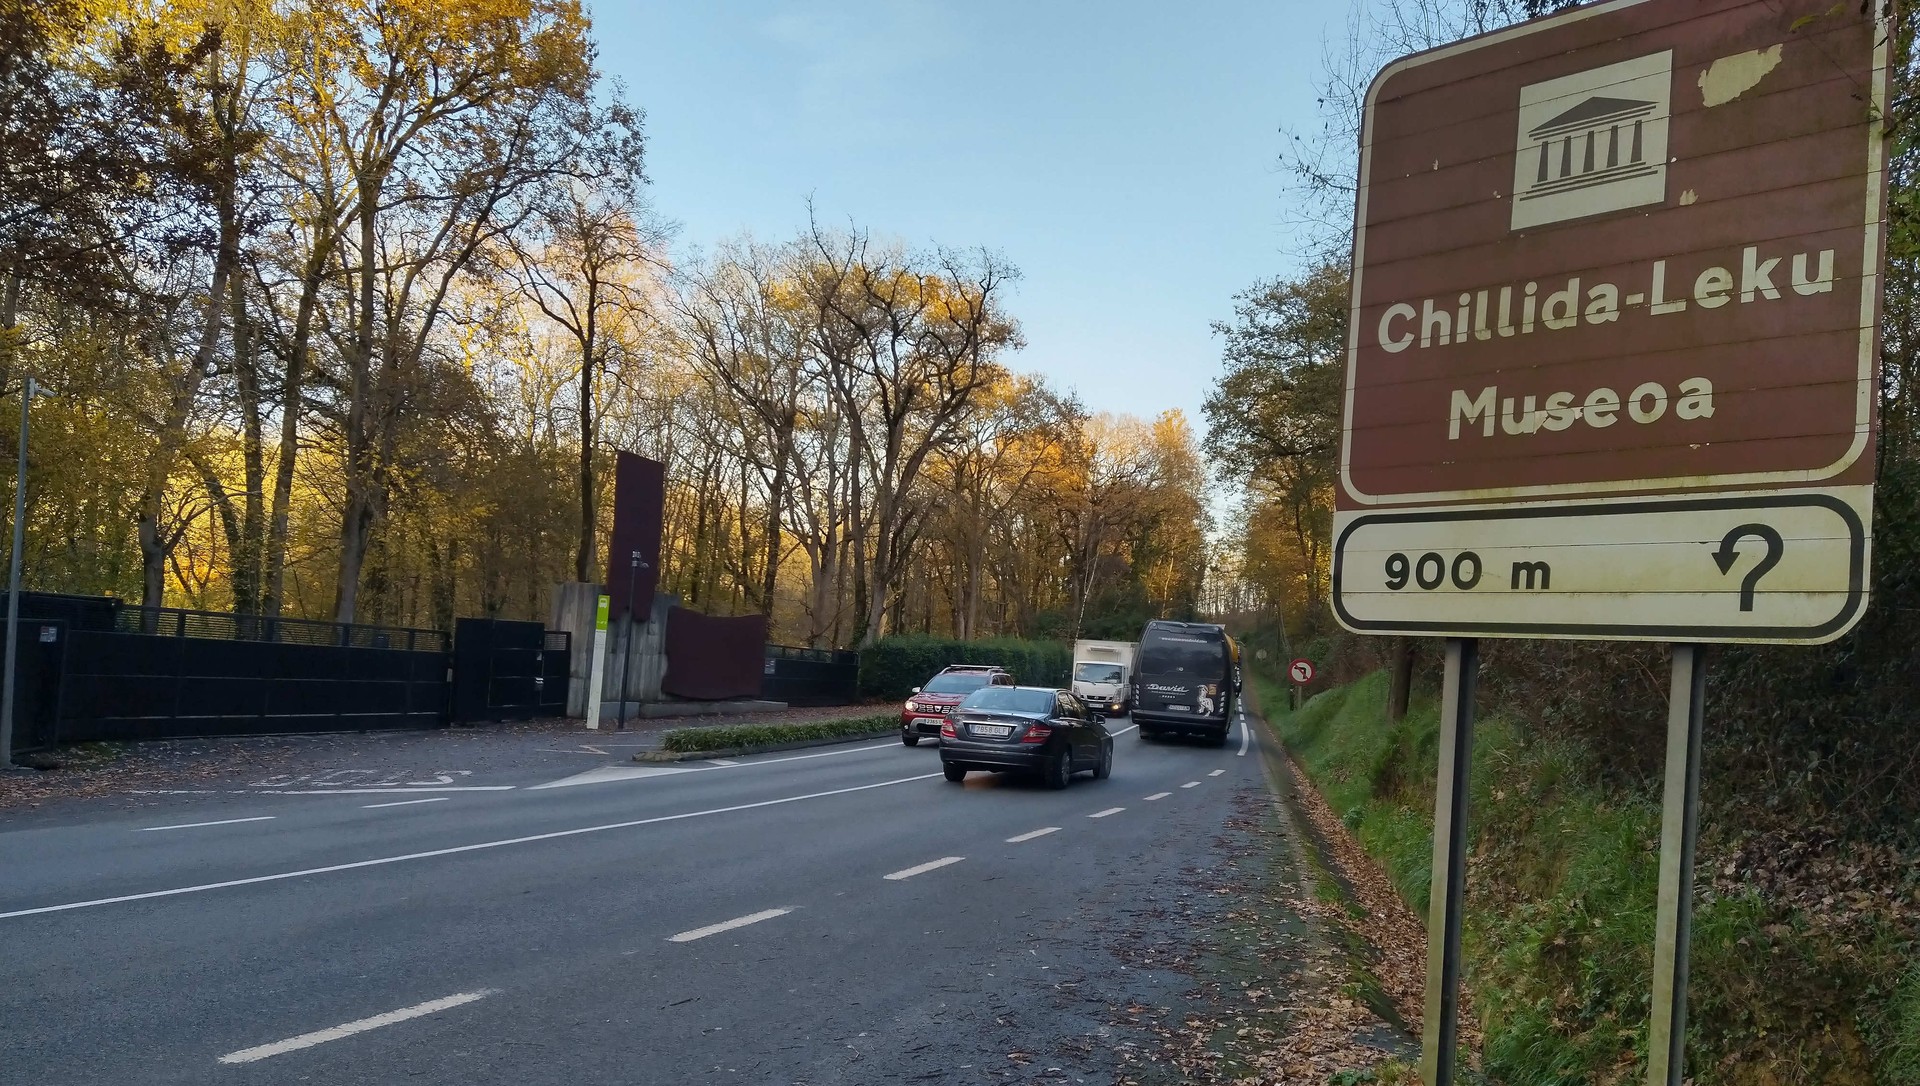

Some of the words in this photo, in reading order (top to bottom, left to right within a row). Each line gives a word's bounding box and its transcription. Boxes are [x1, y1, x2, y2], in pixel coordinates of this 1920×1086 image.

[1377, 246, 1835, 353] Chillida-Leku
[1448, 377, 1716, 440] Museoa
[1384, 551, 1482, 590] 900
[1510, 560, 1550, 590] m
